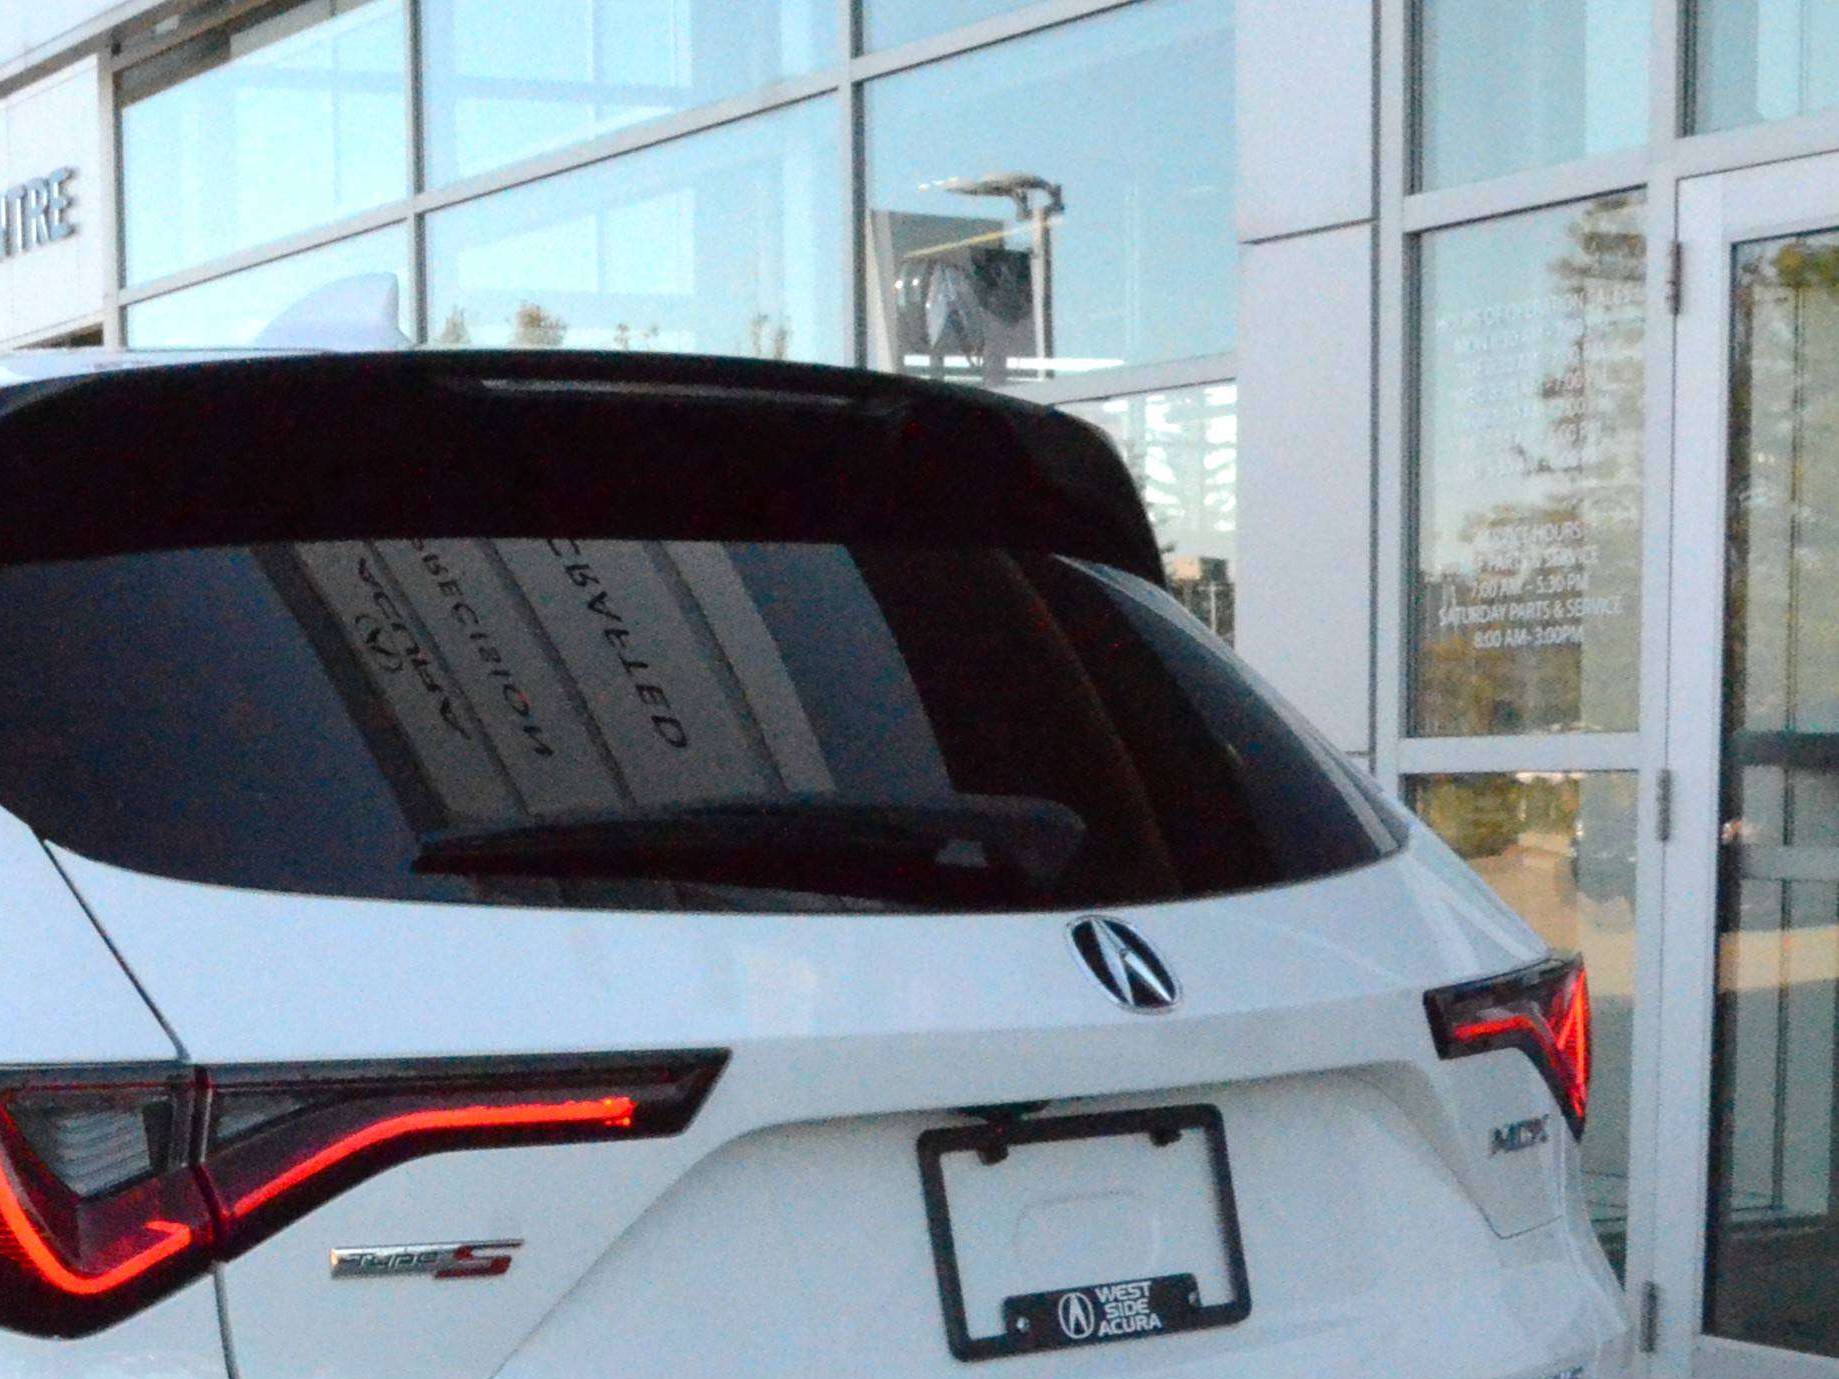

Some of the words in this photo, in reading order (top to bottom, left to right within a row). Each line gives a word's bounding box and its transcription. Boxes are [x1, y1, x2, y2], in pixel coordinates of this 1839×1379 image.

[1509, 600, 1550, 622] PARTS
[1553, 600, 1564, 619] &
[1094, 1281, 1152, 1303] WEST
[1104, 1298, 1151, 1319] SIDE
[1097, 1312, 1163, 1337] ACURA
